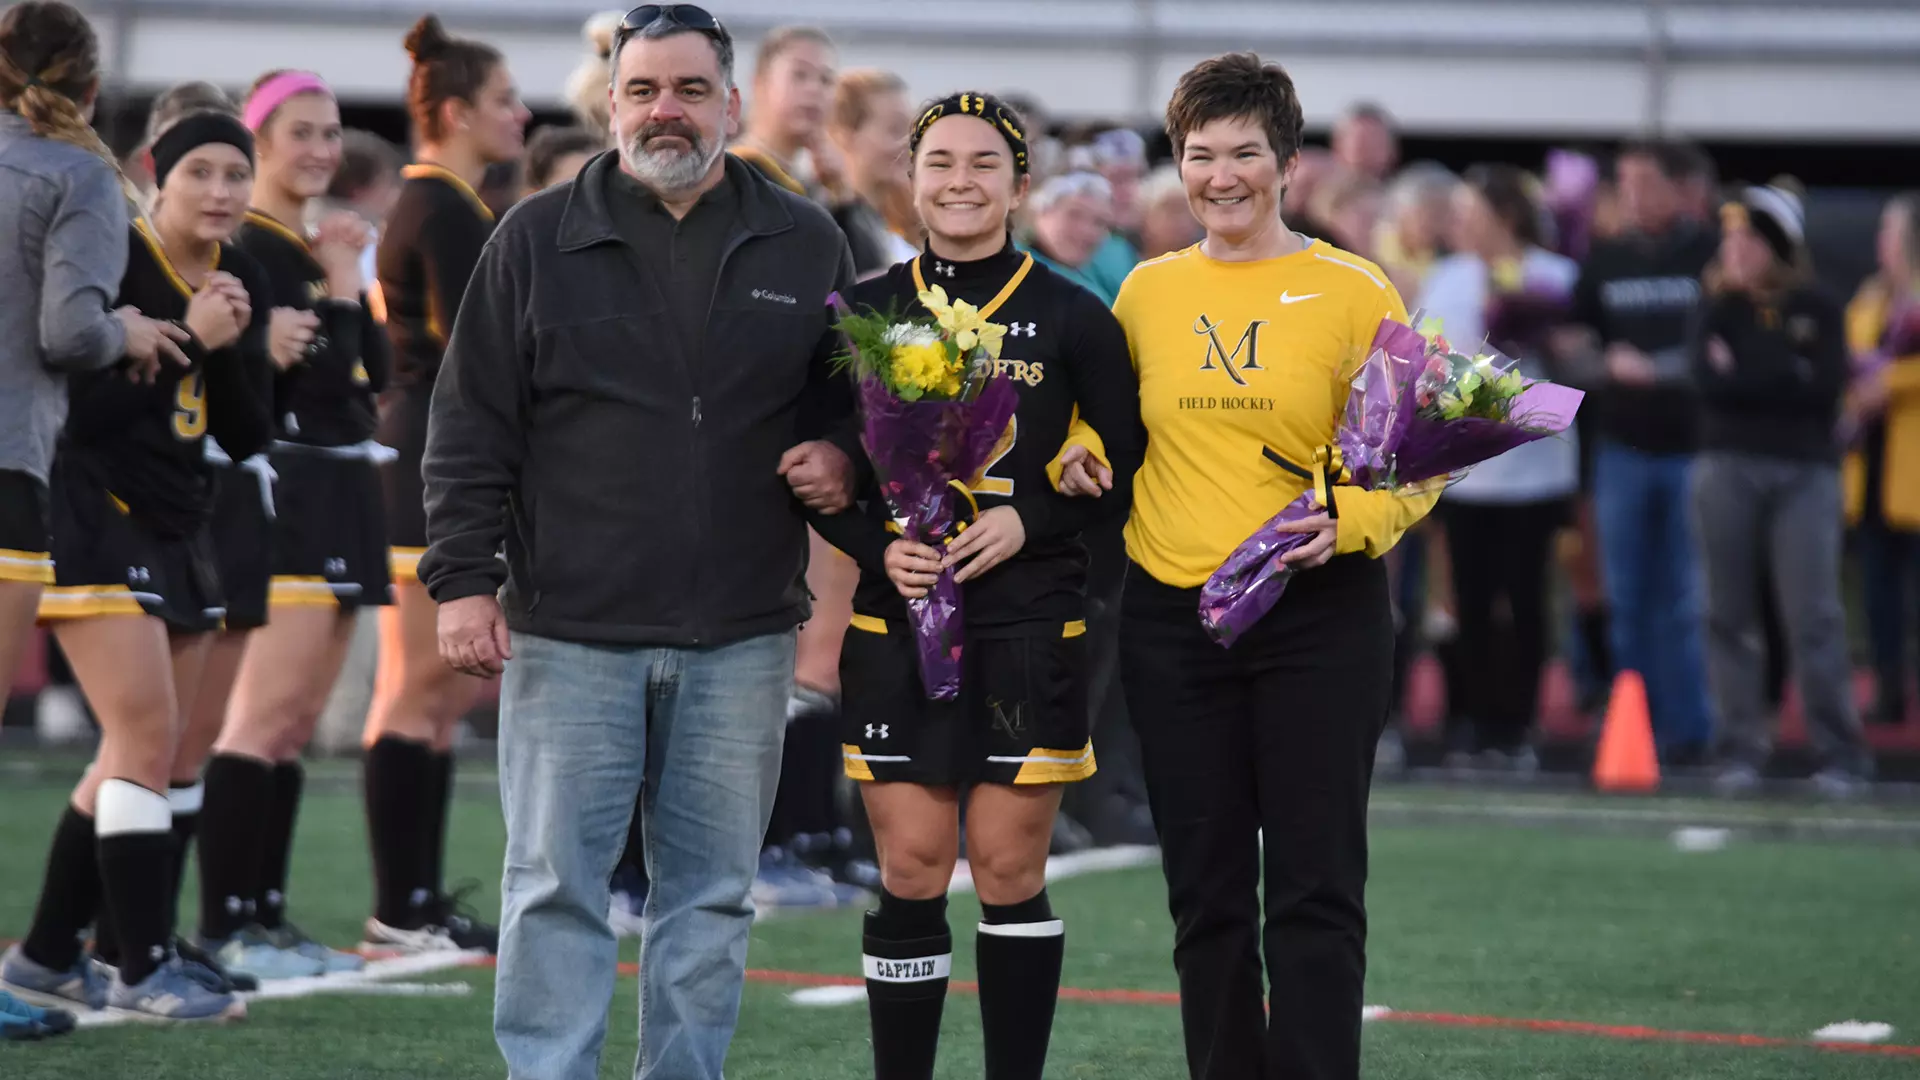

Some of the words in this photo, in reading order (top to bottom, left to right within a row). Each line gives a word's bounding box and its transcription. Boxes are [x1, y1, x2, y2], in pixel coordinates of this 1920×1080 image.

[762, 289, 797, 304] Columbia
[1194, 313, 1269, 387] M
[969, 358, 1045, 387] DERS
[1178, 396, 1217, 410] FIELD
[1221, 396, 1276, 411] HOCKEY
[876, 959, 936, 978] CAPTAIN
